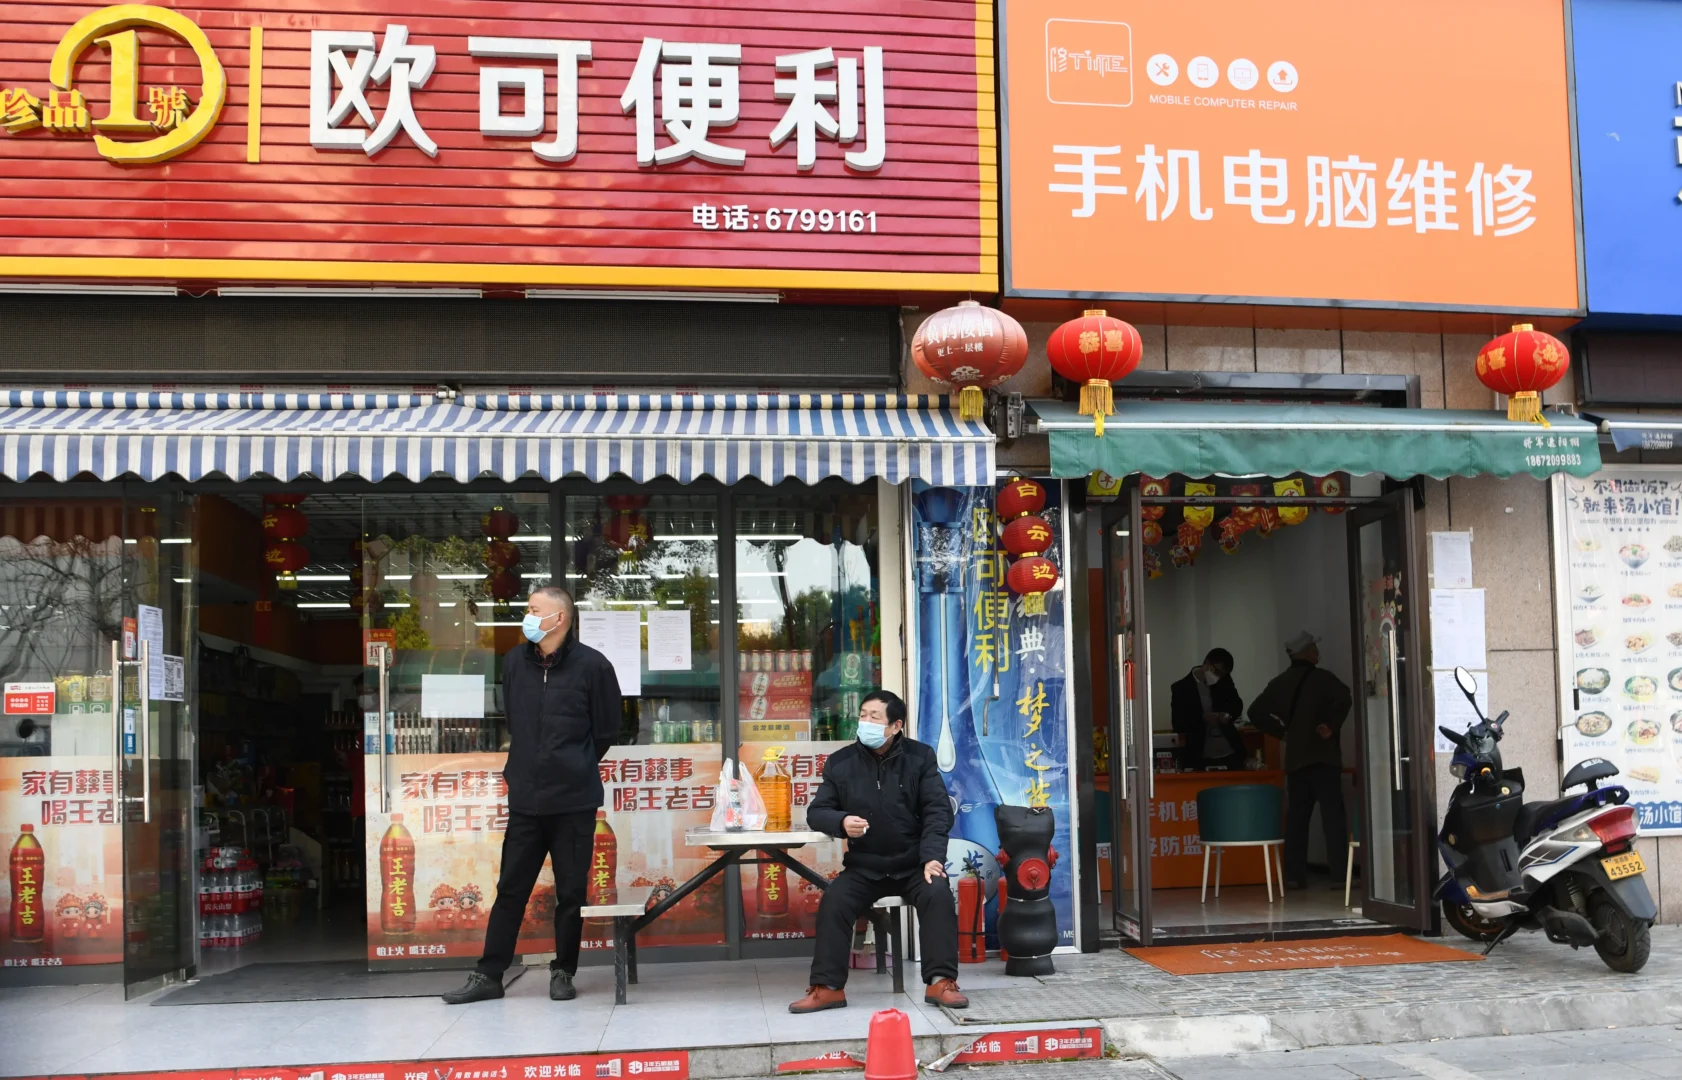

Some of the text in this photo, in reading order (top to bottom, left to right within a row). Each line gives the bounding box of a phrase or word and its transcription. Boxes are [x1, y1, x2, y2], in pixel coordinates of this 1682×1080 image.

[309, 24, 887, 172] 欧可便利
[1149, 94, 1298, 111] MOBILE COMPUTER REPAIR
[1048, 143, 1536, 237] 手机电脑维修
[937, 342, 984, 358] 更上一层楼
[1525, 454, 1582, 466] 18672099883
[612, 785, 717, 812] 喝王老吉
[1639, 805, 1682, 825] 汤小馆
[1611, 861, 1642, 876] 43552
[389, 857, 408, 917] 王老吉
[18, 866, 36, 925] 王老吉
[777, 931, 805, 939] 喝王老吉
[376, 944, 446, 957] 怕上火 喝王老吉
[581, 940, 602, 948] 怕上火
[4, 956, 63, 967] 怕上火 喝王老吉
[524, 1063, 581, 1078] 欢迎光临
